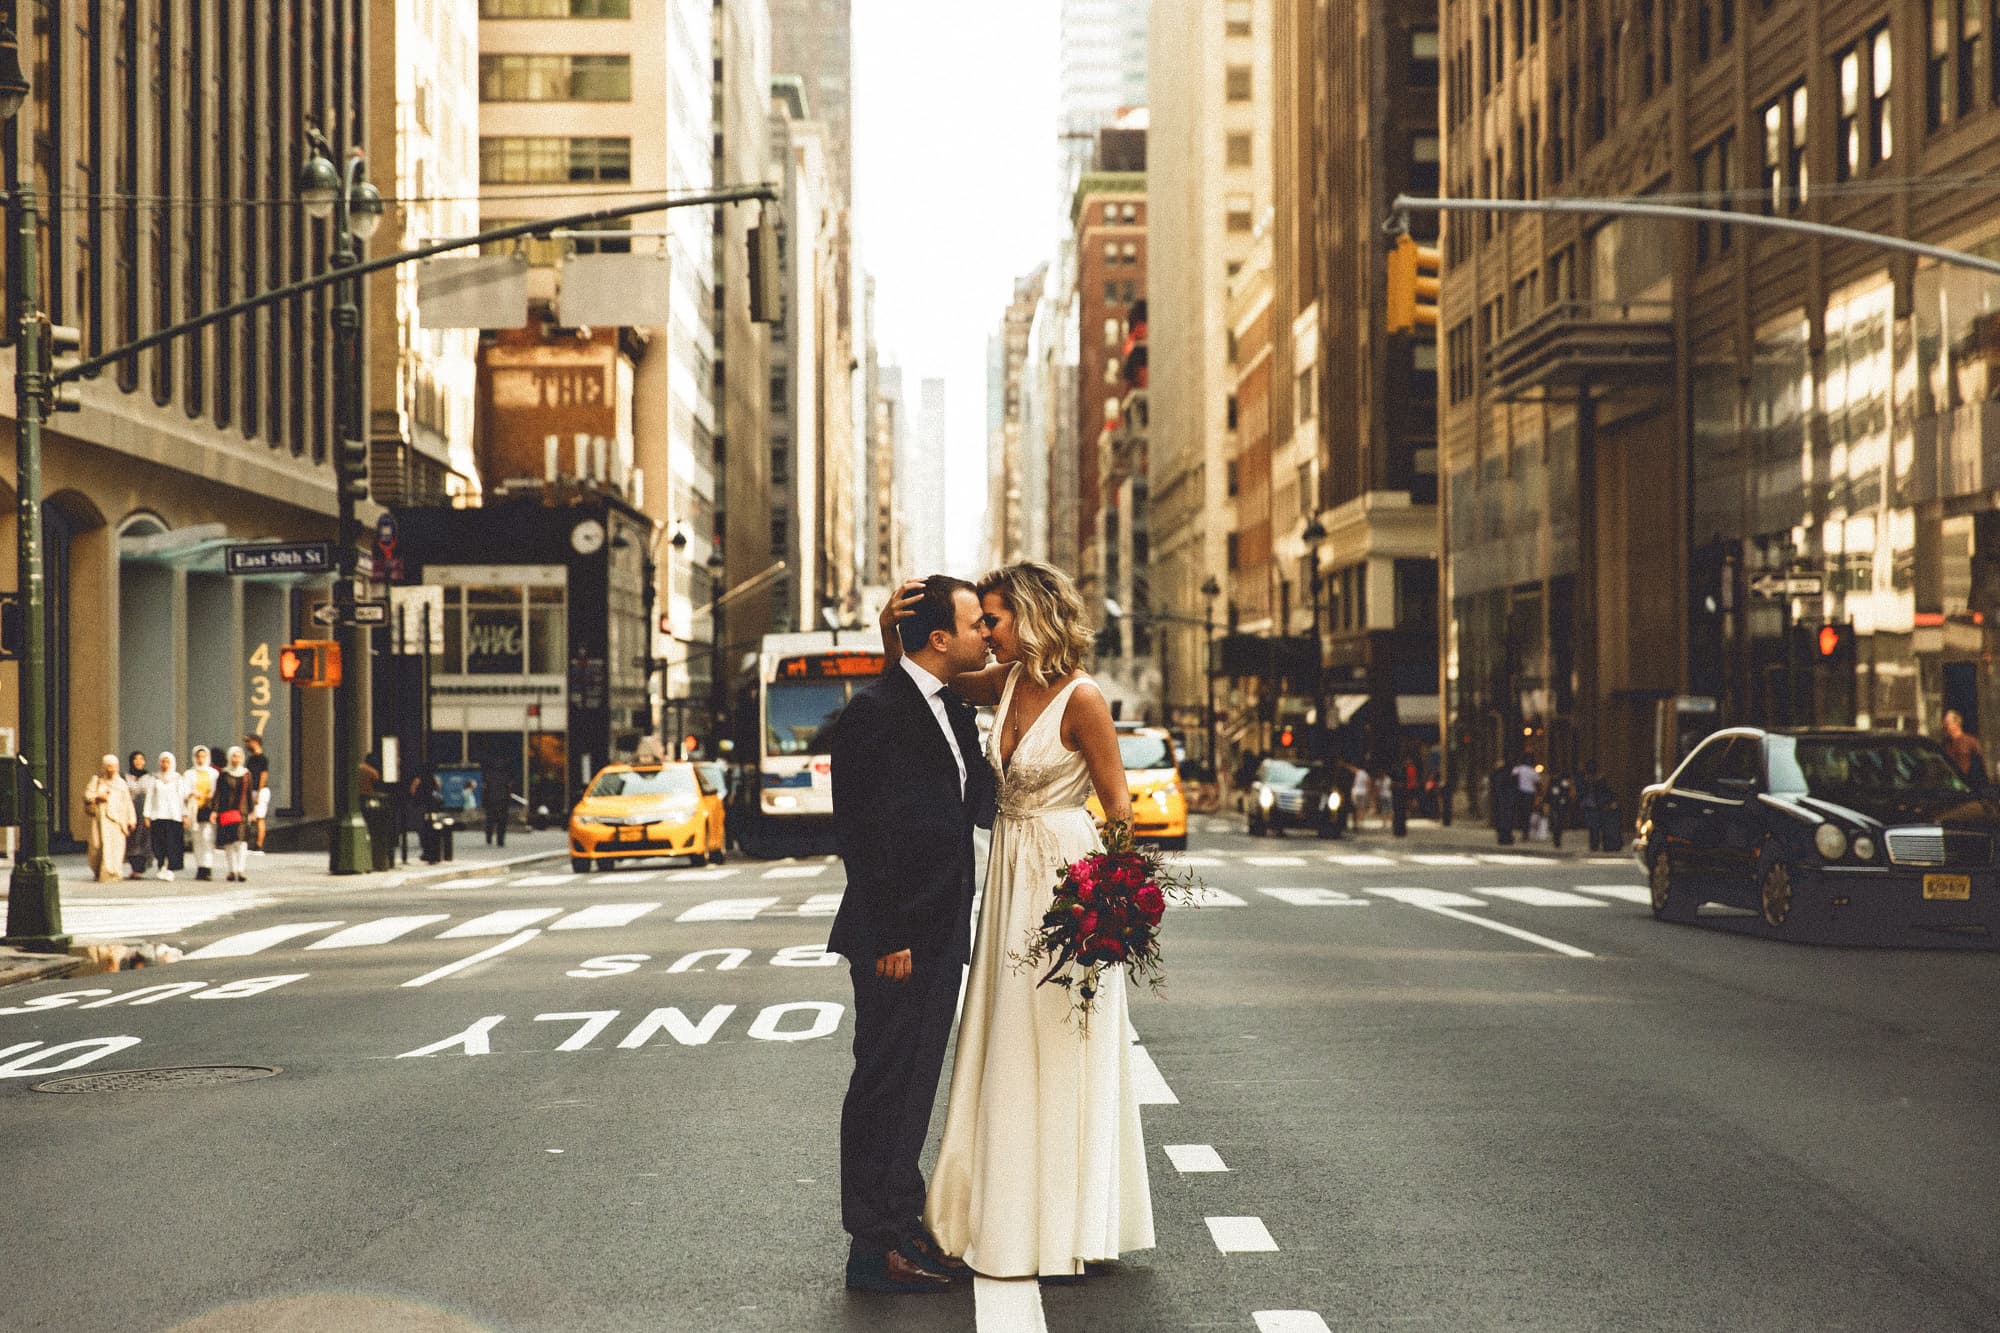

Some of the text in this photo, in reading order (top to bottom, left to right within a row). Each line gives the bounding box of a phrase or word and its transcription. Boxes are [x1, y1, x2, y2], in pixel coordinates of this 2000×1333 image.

[235, 549, 321, 567] East 50th St
[249, 642, 271, 737] 437
[566, 944, 840, 978] BUS
[0, 973, 310, 1015] BUS
[395, 1001, 845, 1058] ONLY
